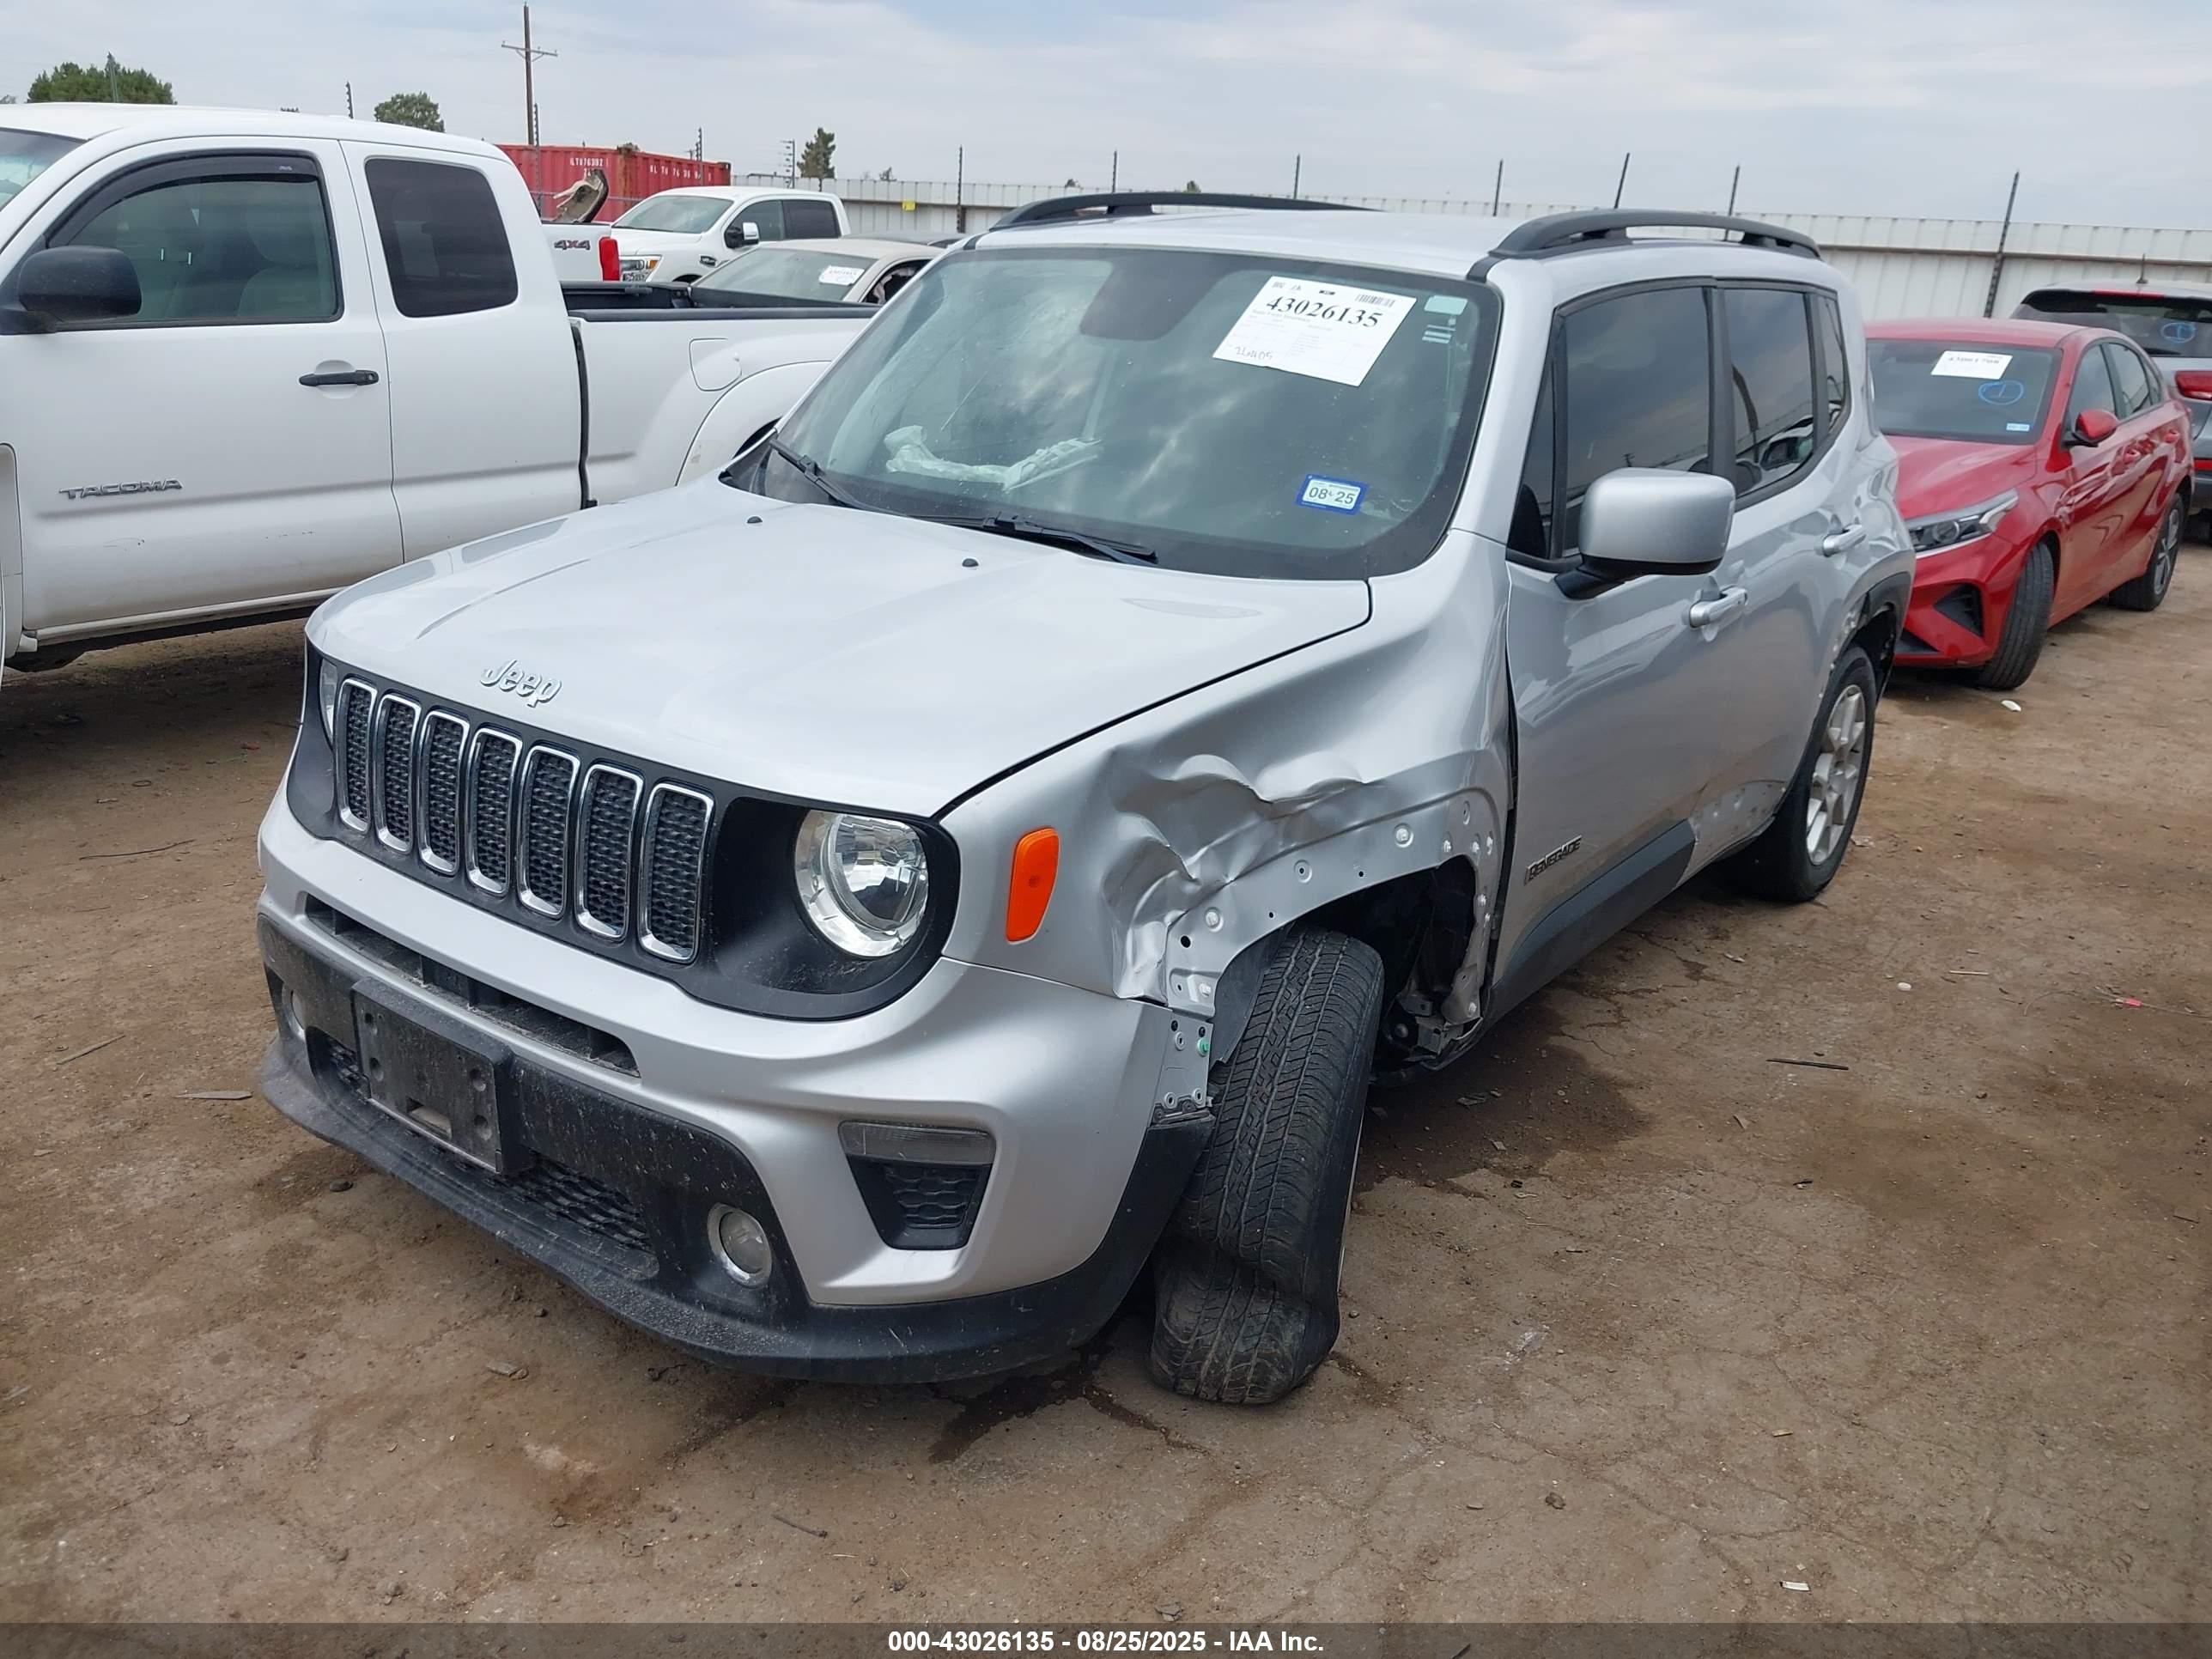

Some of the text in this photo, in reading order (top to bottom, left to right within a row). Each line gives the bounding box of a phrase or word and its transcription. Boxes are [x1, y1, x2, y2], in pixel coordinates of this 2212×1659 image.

[1266, 295, 1383, 328] 43026135
[58, 477, 184, 500] TACOMA
[1309, 487, 1328, 499] 08
[1334, 491, 1355, 504] 25
[480, 659, 562, 708] Jeep
[1524, 835, 1582, 886] RENEGADE
